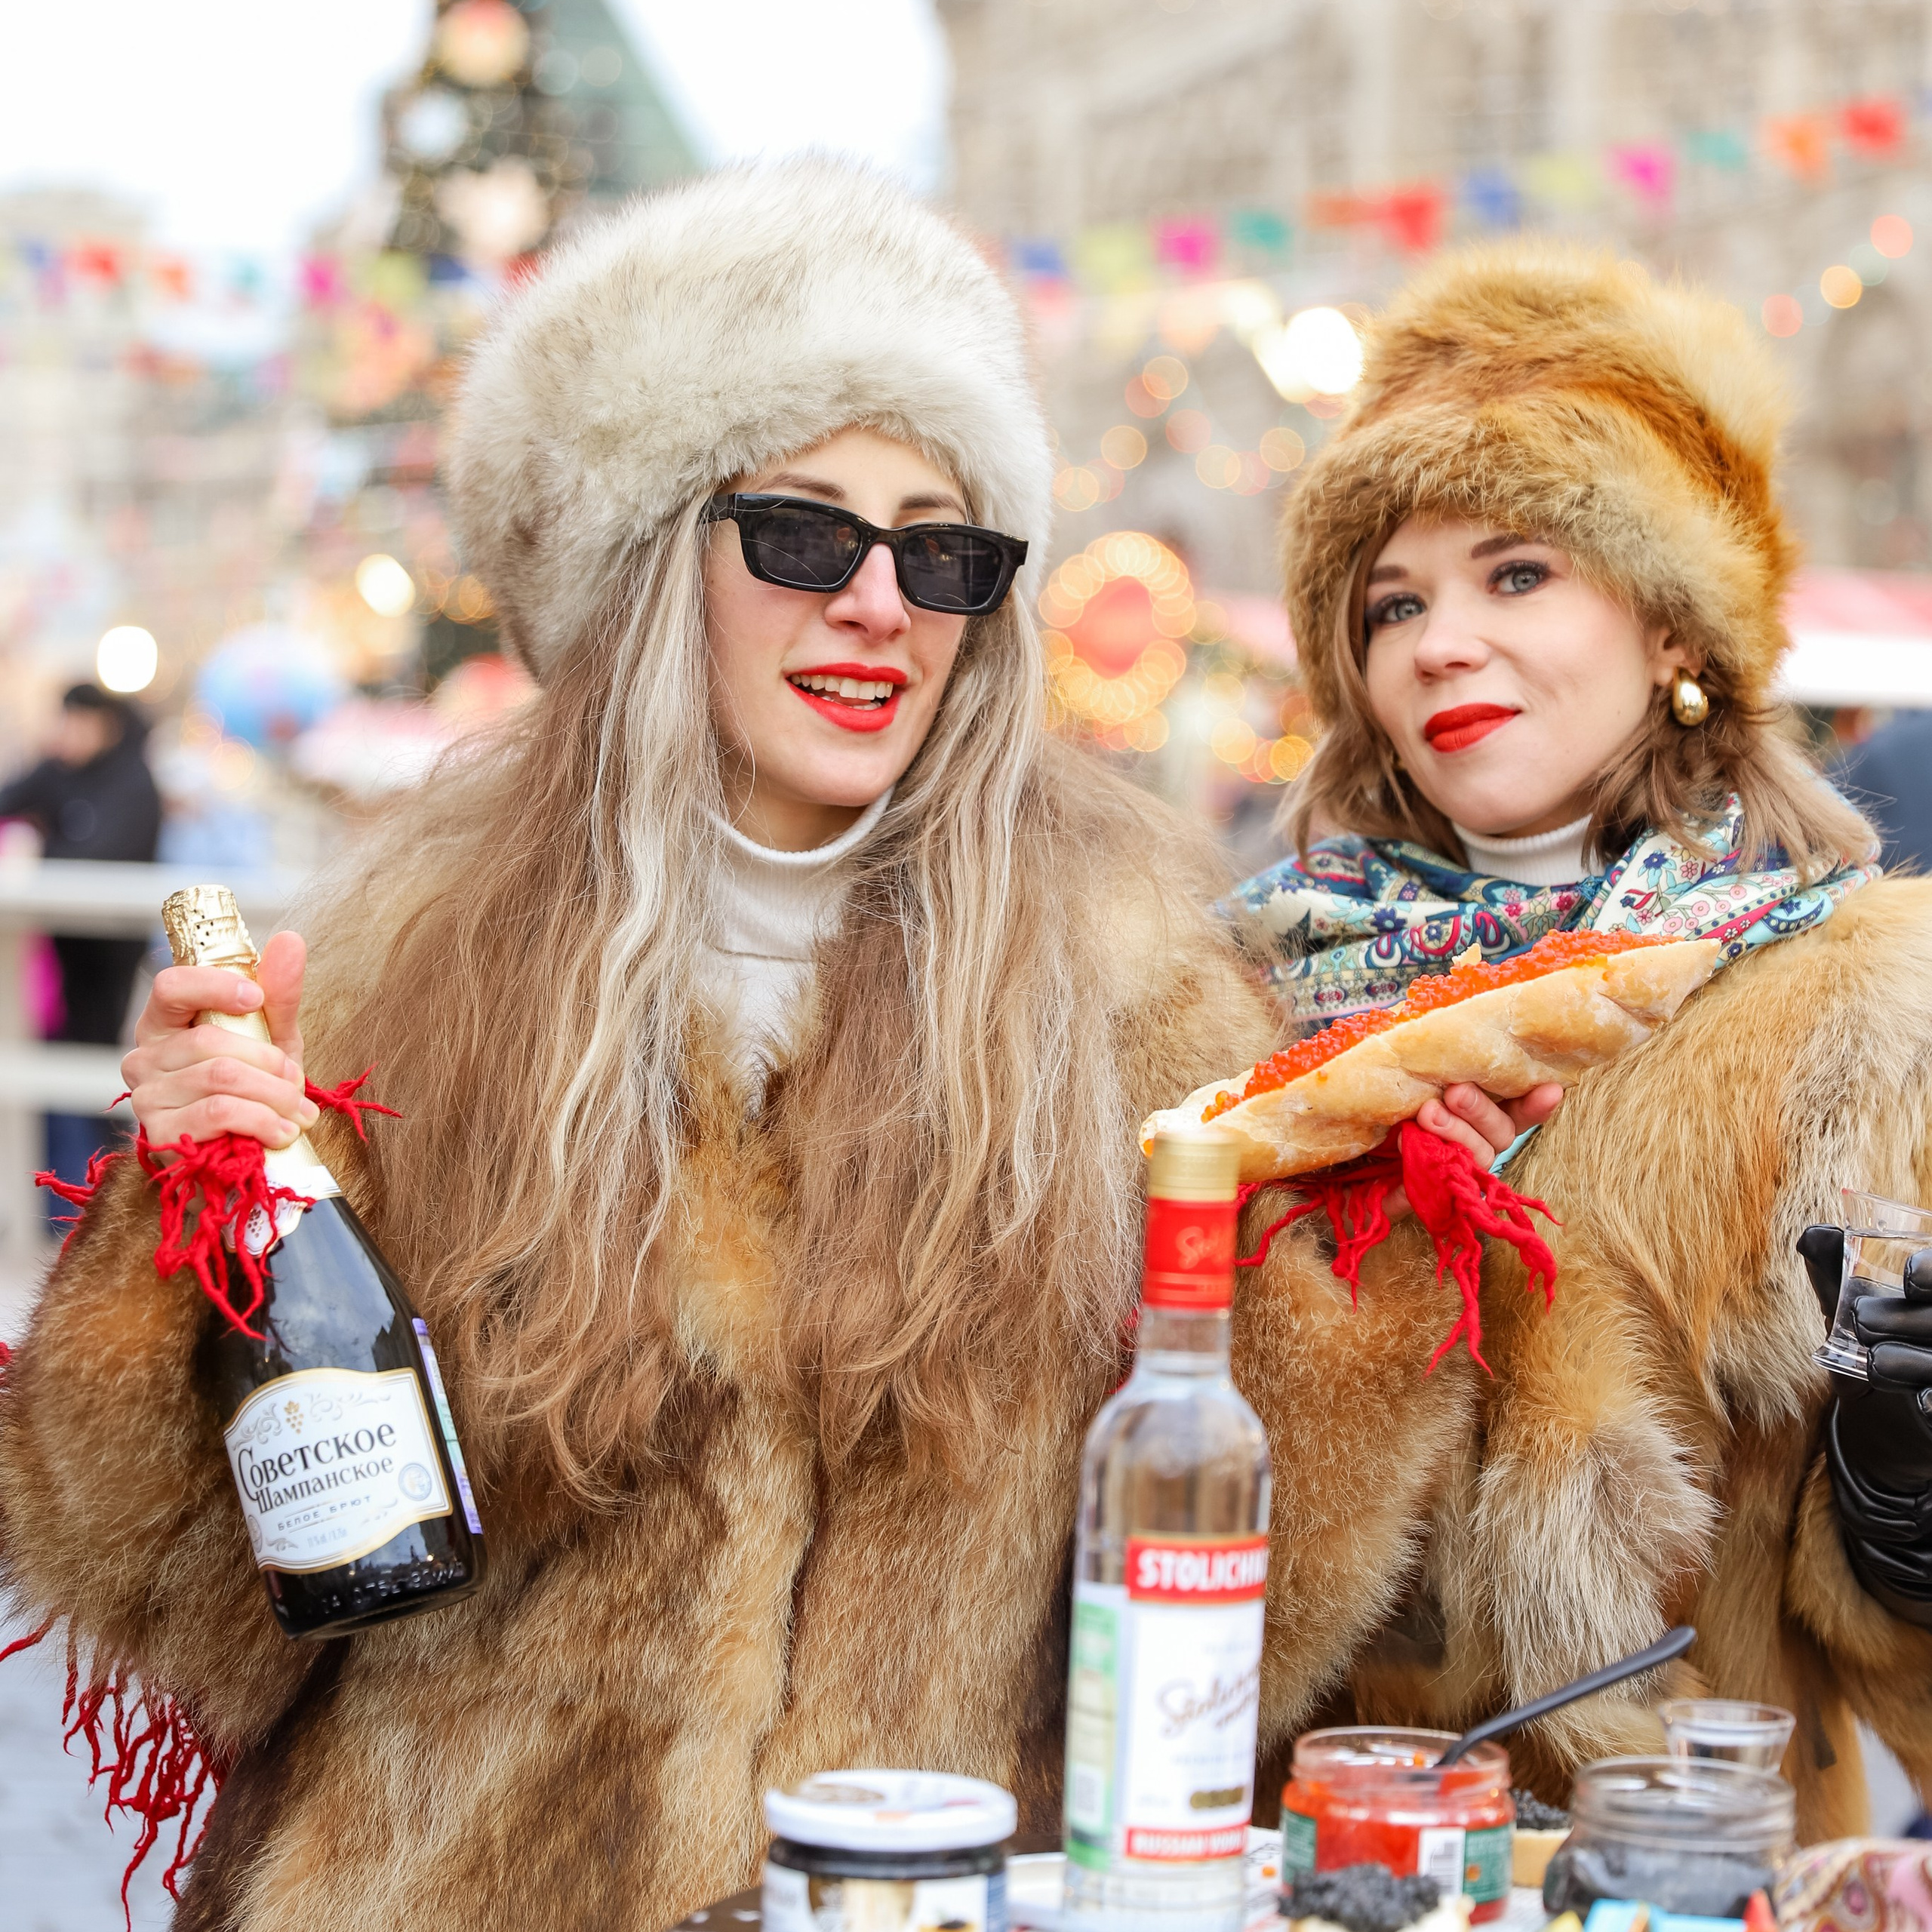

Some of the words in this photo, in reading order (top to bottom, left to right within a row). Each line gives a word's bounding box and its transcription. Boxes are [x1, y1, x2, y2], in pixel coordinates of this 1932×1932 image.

[238, 1423, 397, 1501] Советское
[255, 1457, 394, 1514] Шампанское
[329, 1496, 372, 1513] БРЮТ
